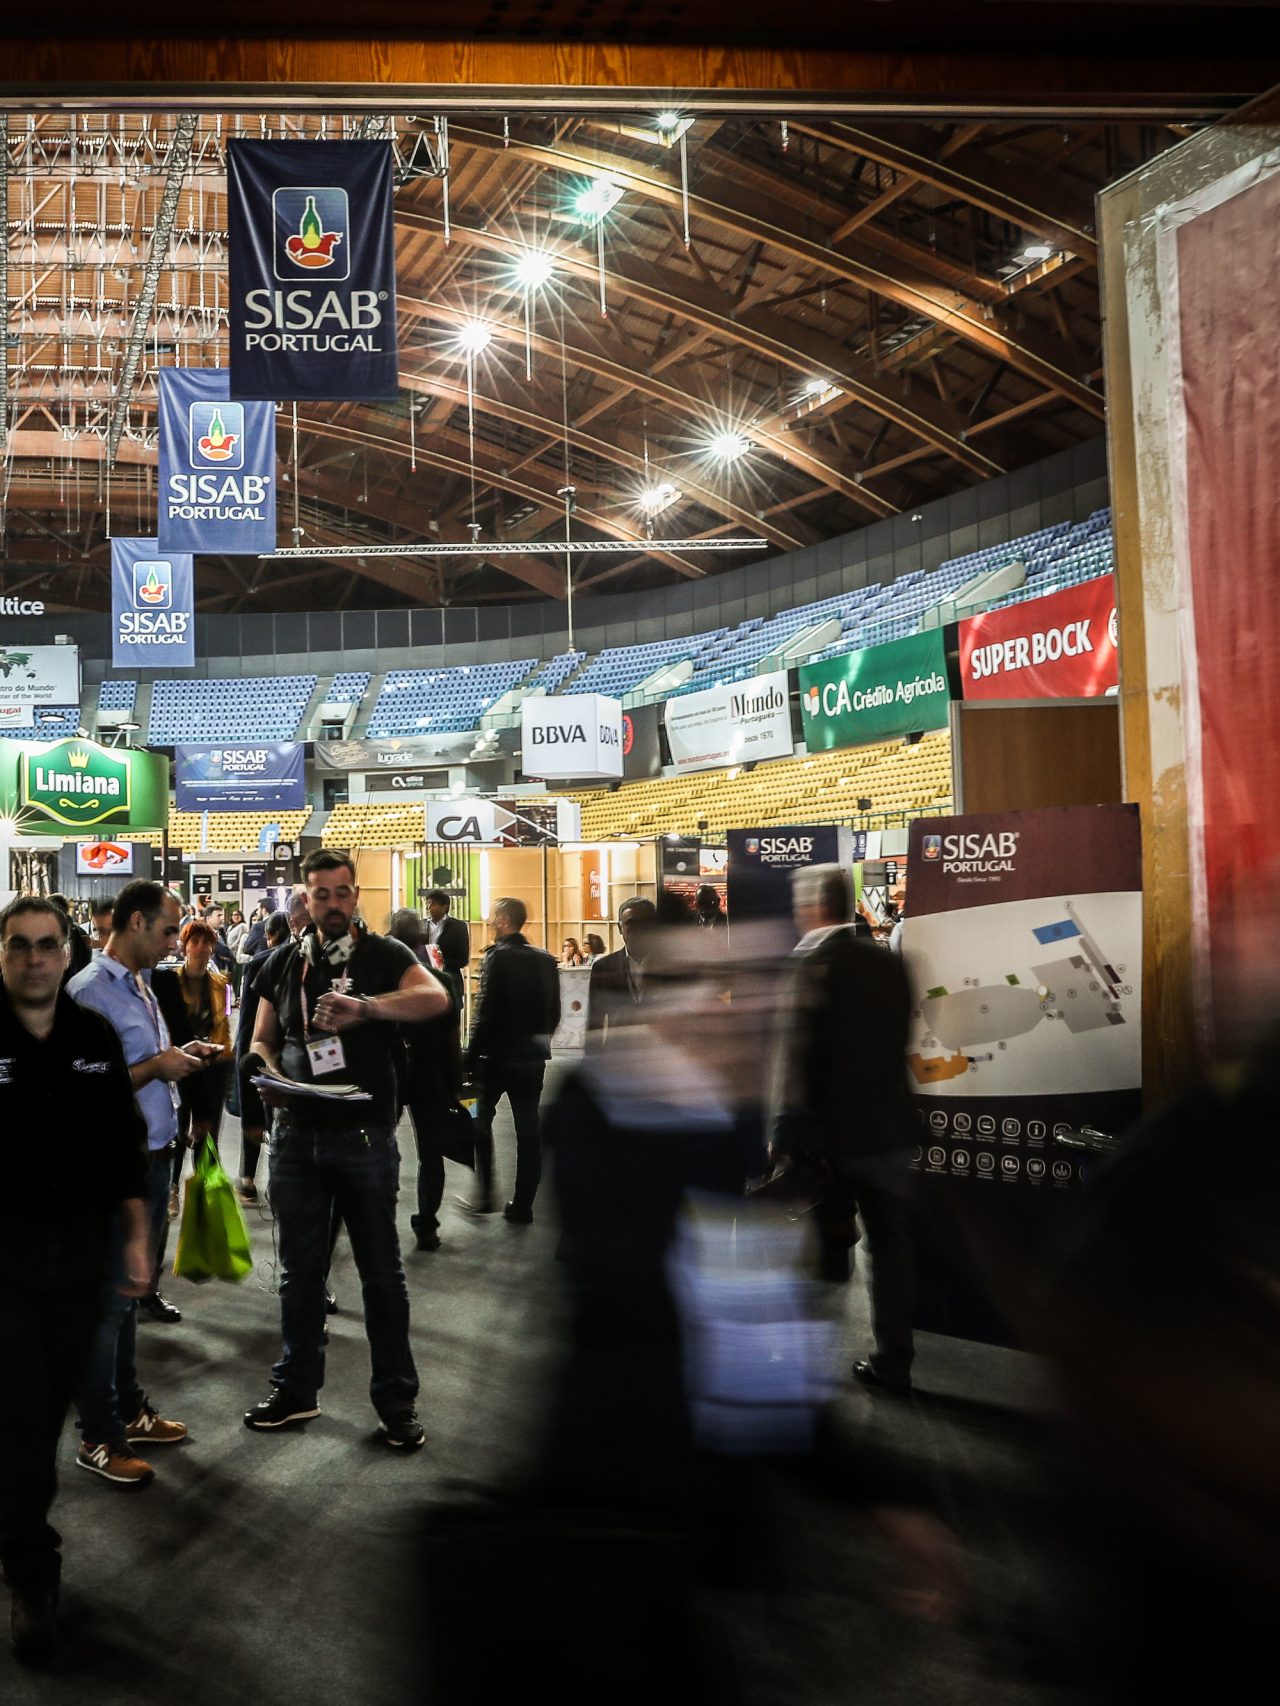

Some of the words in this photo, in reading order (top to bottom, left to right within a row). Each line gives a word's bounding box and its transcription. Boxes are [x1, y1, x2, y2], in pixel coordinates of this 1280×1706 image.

[245, 333, 382, 352] PORTUGAL
[168, 474, 266, 505] SISAB
[168, 505, 266, 521] PORTUGAL
[119, 612, 187, 633] SISAB
[119, 634, 187, 645] PORTUGAL
[970, 636, 1030, 681] SUPER
[1032, 618, 1093, 666] BOCK
[730, 686, 784, 718] Mundo
[822, 679, 853, 718] CA
[853, 684, 894, 711] Crédito
[895, 671, 946, 705] Agrícola
[531, 724, 587, 745] BBVA
[599, 724, 620, 747] BBVA
[377, 751, 413, 765] lugrade
[35, 767, 120, 796] Limiana
[436, 815, 482, 841] CA
[760, 836, 813, 855] SISAB
[942, 832, 1017, 861] SISAB
[760, 854, 813, 863] PORTUGAL
[942, 859, 1016, 874] PORTUGAL
